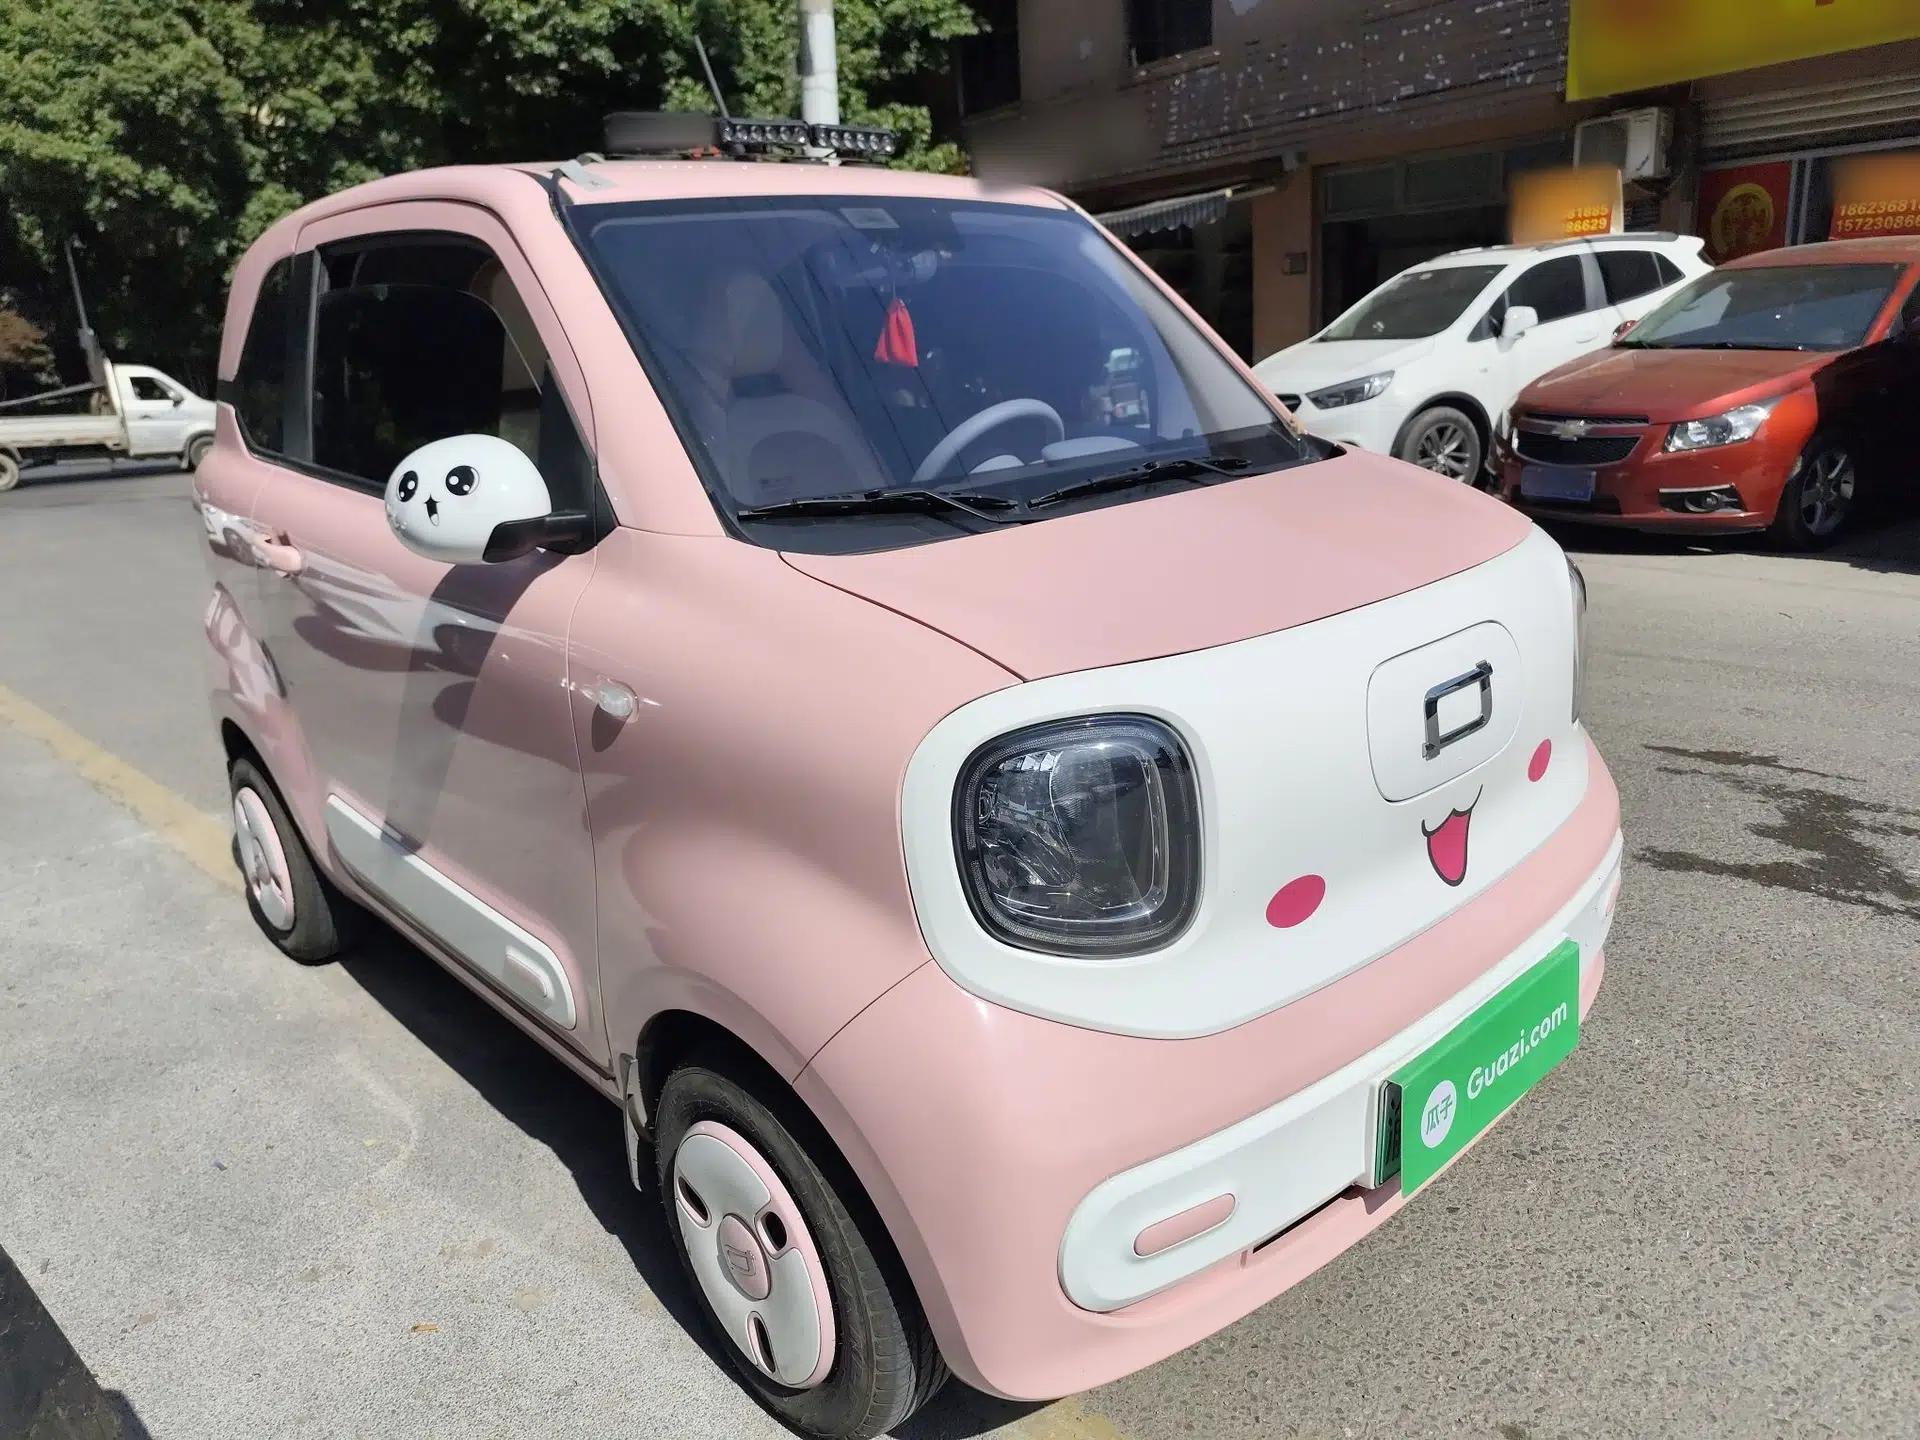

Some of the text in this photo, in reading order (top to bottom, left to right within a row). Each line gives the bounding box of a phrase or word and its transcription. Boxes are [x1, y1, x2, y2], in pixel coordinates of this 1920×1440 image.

[1840, 199, 1920, 216] 18623681
[1467, 1002, 1567, 1100] Guazi.com
[1426, 1094, 1453, 1135] 瓜子
